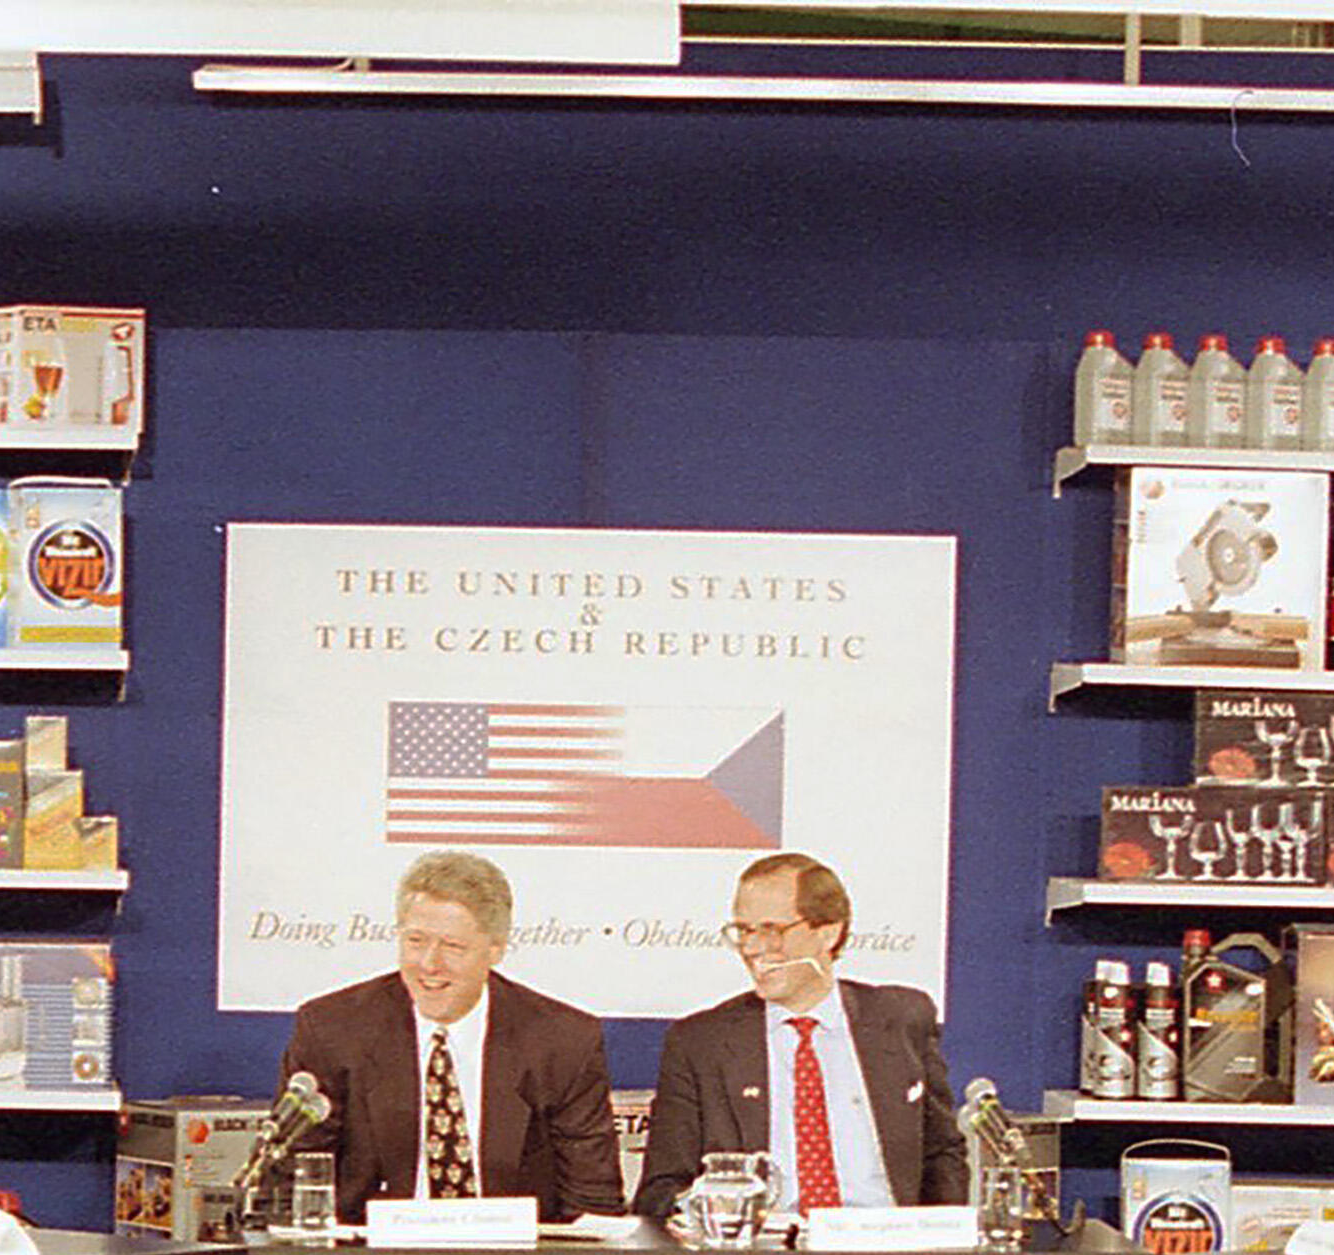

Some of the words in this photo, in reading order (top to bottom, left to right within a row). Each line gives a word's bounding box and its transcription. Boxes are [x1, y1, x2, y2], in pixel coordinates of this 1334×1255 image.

[23, 317, 56, 332] ETA
[337, 569, 429, 596] THE
[458, 571, 644, 600] UNITED
[670, 575, 849, 604] STATES
[580, 603, 603, 626] &
[315, 625, 408, 651] THE
[436, 627, 595, 656] CZECH
[624, 631, 868, 661] REPUBLIC
[249, 911, 336, 949] Doing
